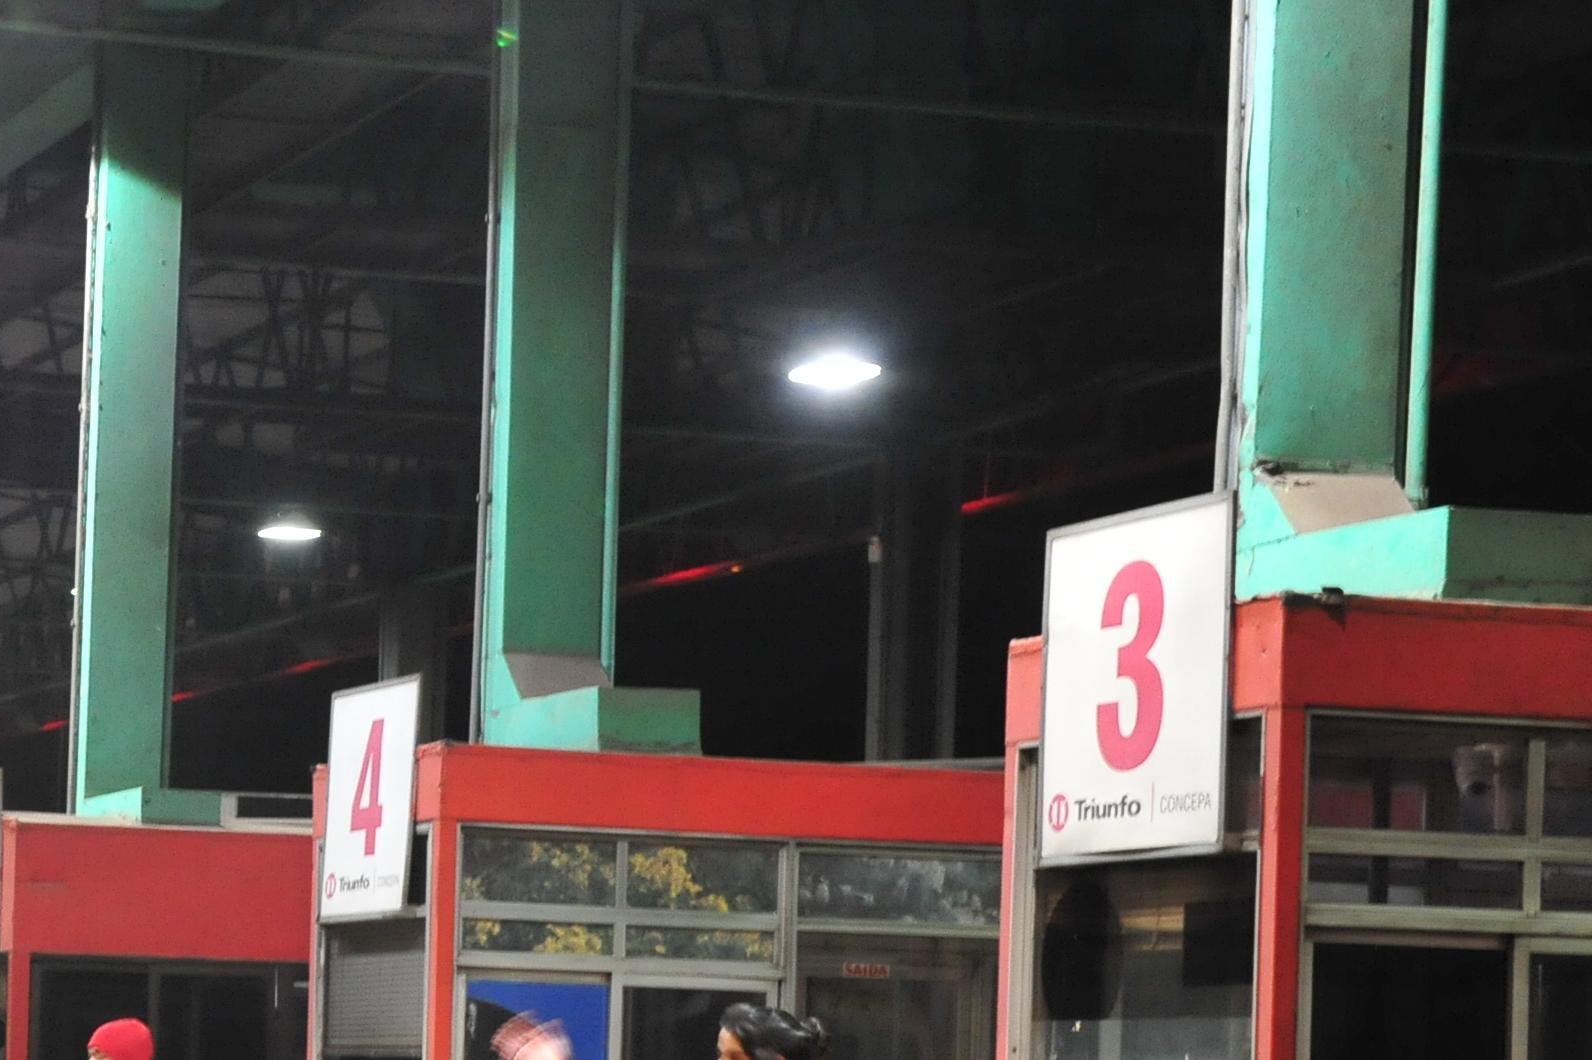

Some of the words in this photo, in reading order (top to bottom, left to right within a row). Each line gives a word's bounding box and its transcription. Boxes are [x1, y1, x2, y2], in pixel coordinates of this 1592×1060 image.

[1096, 560, 1164, 772] 3
[350, 719, 384, 855] 4
[1075, 795, 1142, 821] Triunfo
[1159, 793, 1211, 813] CONCEPA
